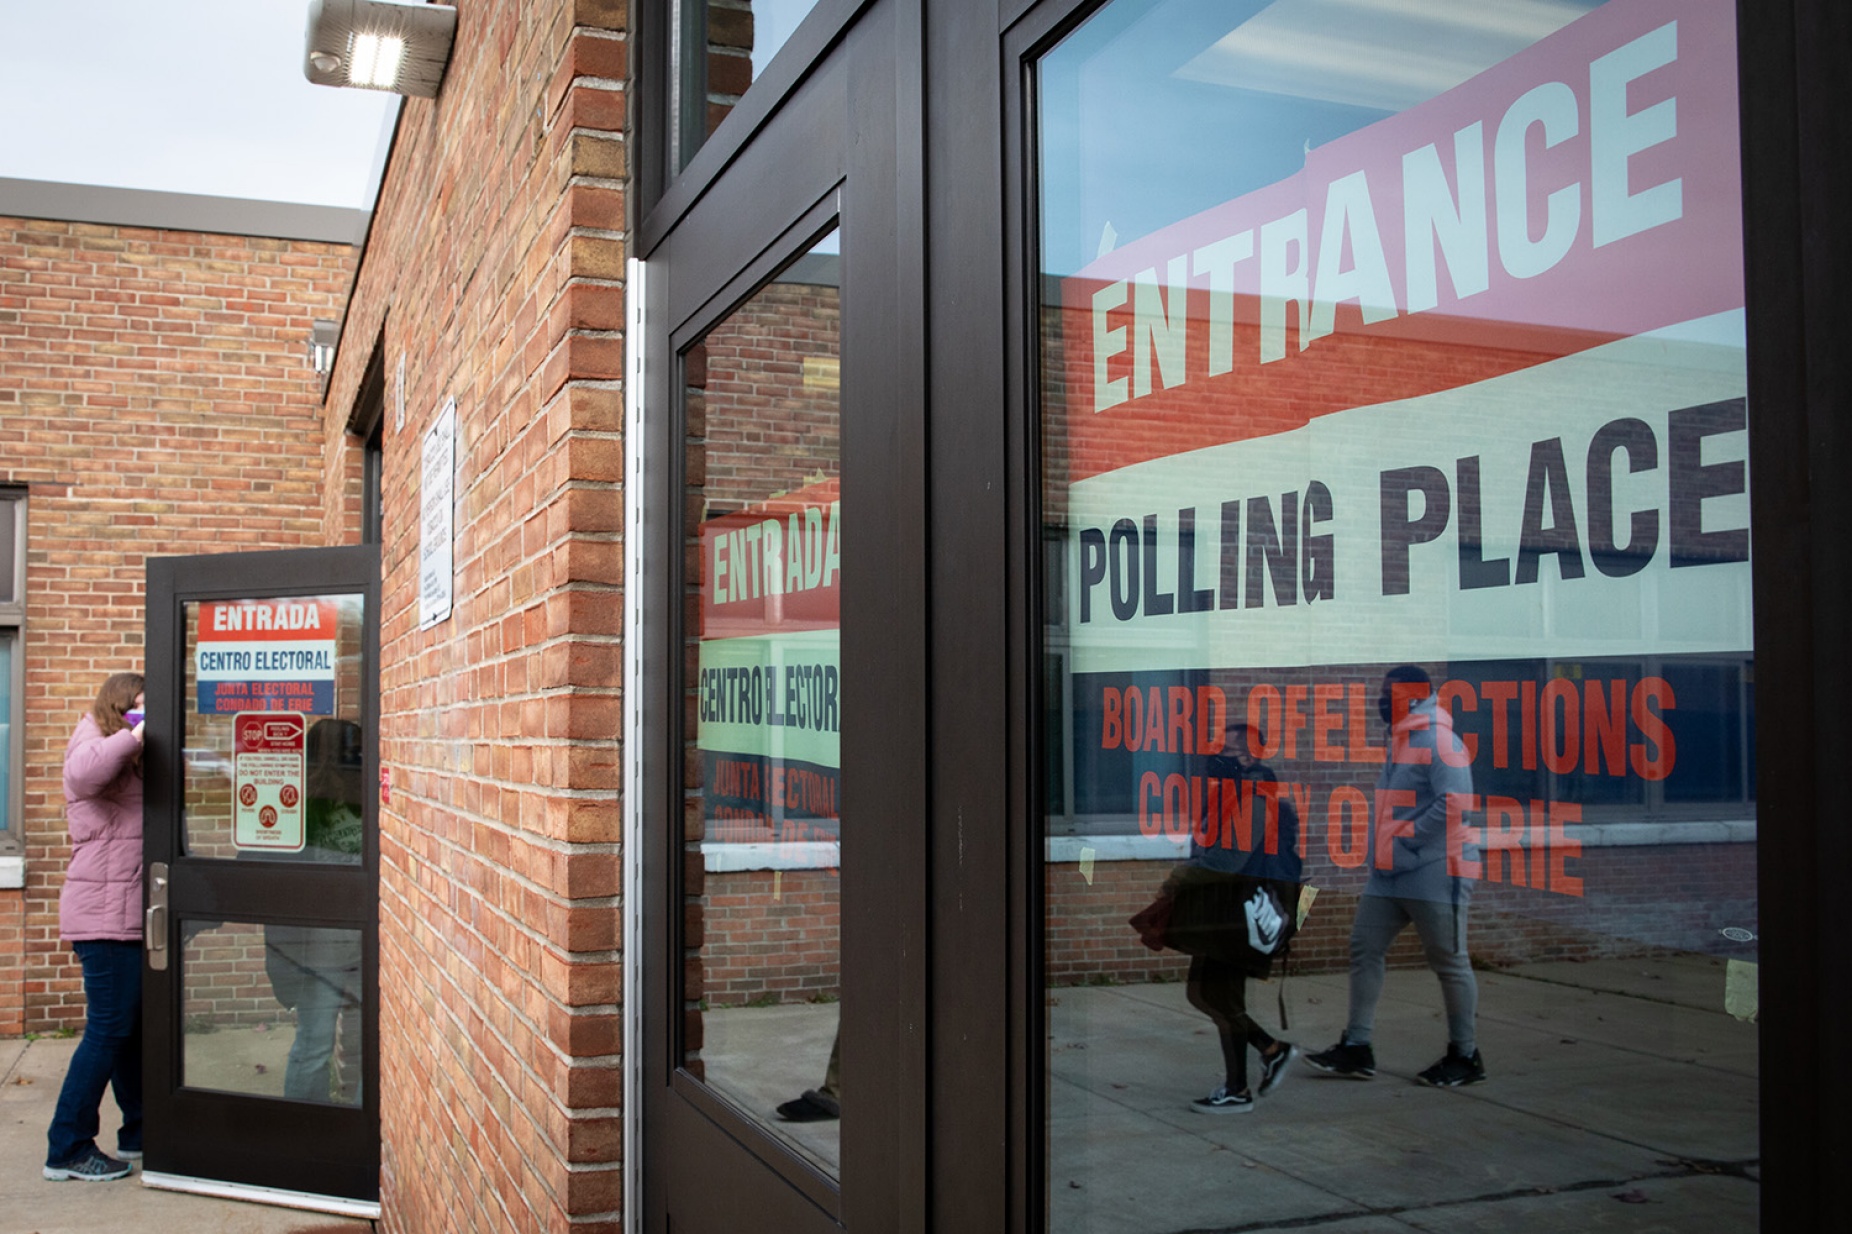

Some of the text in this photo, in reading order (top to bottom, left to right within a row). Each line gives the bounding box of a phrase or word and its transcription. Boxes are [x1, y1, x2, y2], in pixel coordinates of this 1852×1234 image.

[1092, 20, 1683, 414] ENTRANCE
[1079, 396, 1750, 624] POLLING PLACE
[713, 499, 840, 605] ENTRADA
[213, 604, 320, 631] ENTRADA
[200, 650, 332, 671] CENTRO ELECTORAL
[214, 682, 315, 696] JUNTA ELECTORAL
[215, 698, 267, 712] CONDADO
[270, 698, 286, 711] DE
[289, 698, 313, 712] ERIE
[700, 663, 840, 732] CENTRO ELECTOR
[243, 730, 263, 741] STOP
[1102, 685, 1227, 757] BOARD
[713, 759, 761, 801] JUNTA
[1138, 771, 1584, 898] COUNTY OF ERIE
